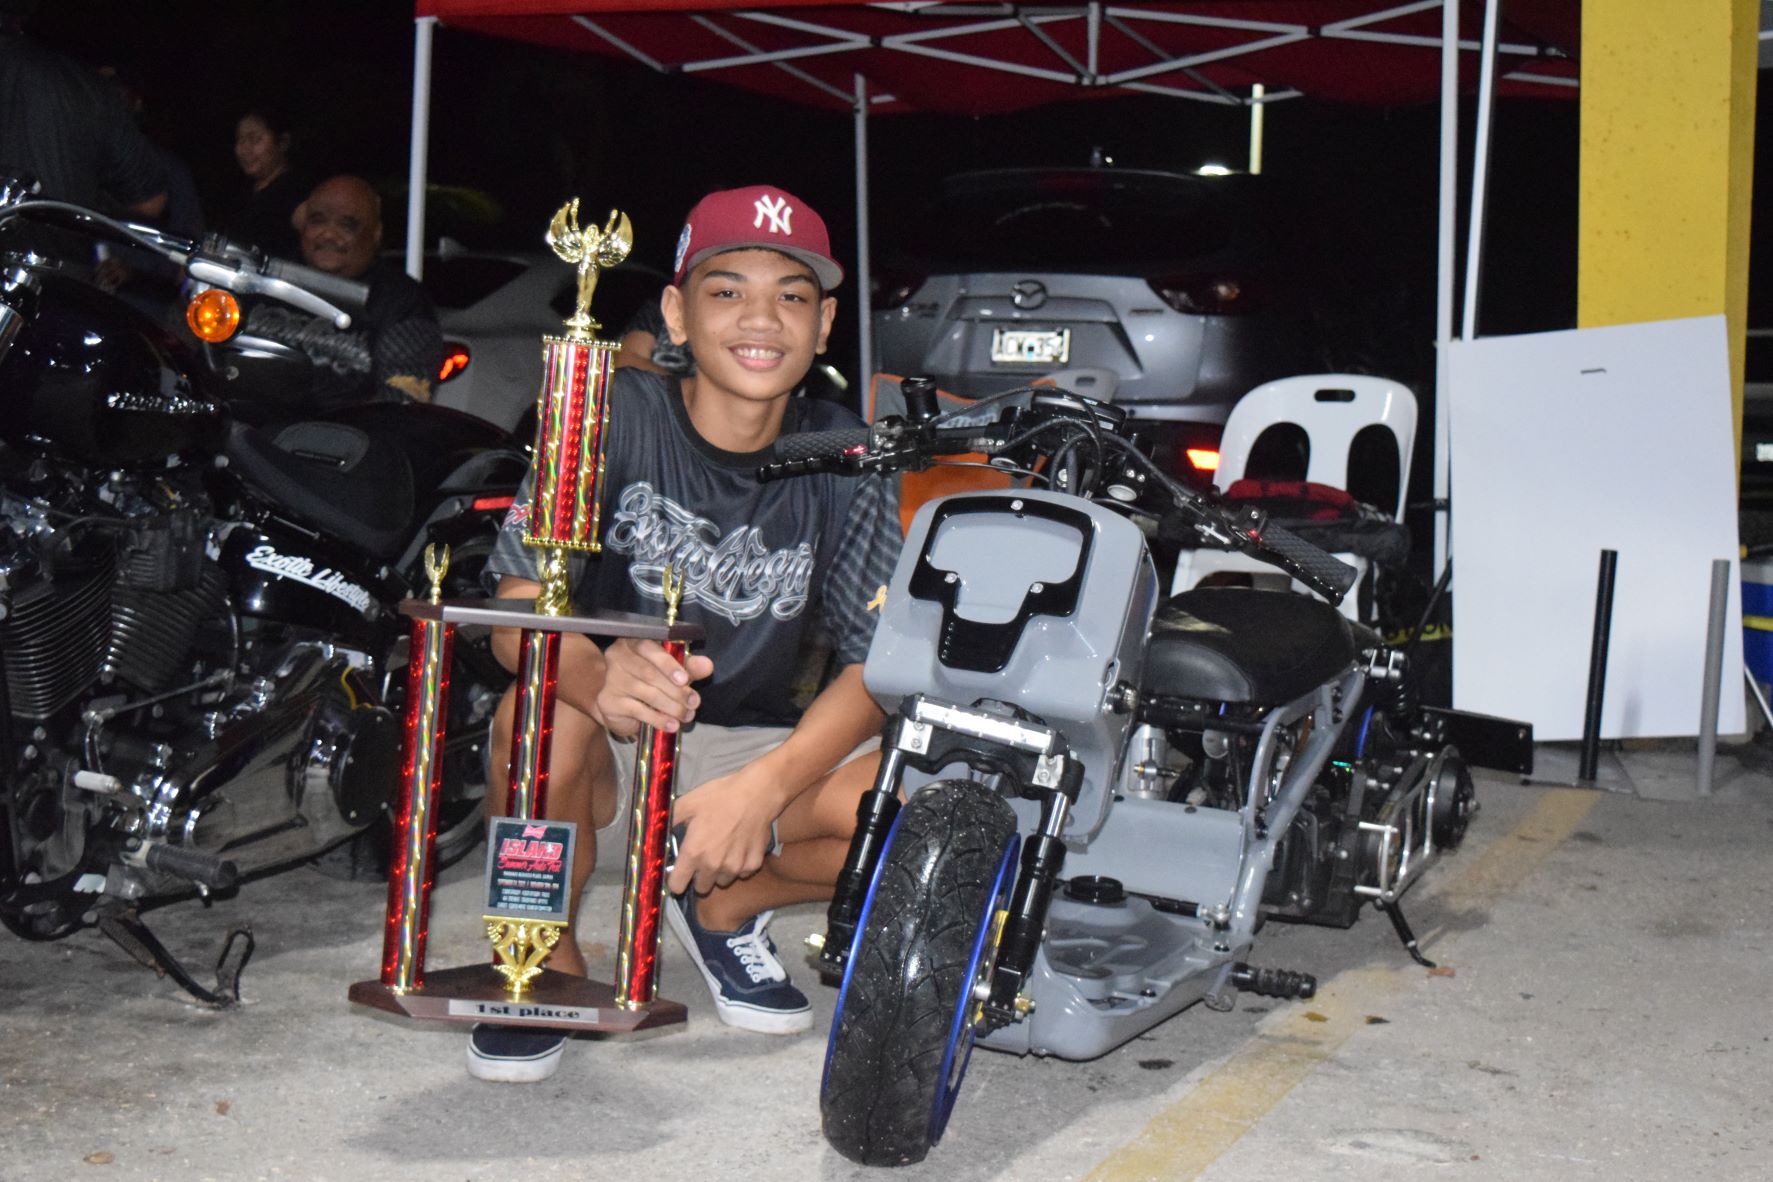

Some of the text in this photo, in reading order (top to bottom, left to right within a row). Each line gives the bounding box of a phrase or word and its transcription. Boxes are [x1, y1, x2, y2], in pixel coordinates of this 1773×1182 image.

[753, 194, 793, 236] NY
[245, 545, 315, 578] Exotic
[499, 838, 563, 860] ISLAND
[477, 1004, 580, 1018] 1st place
